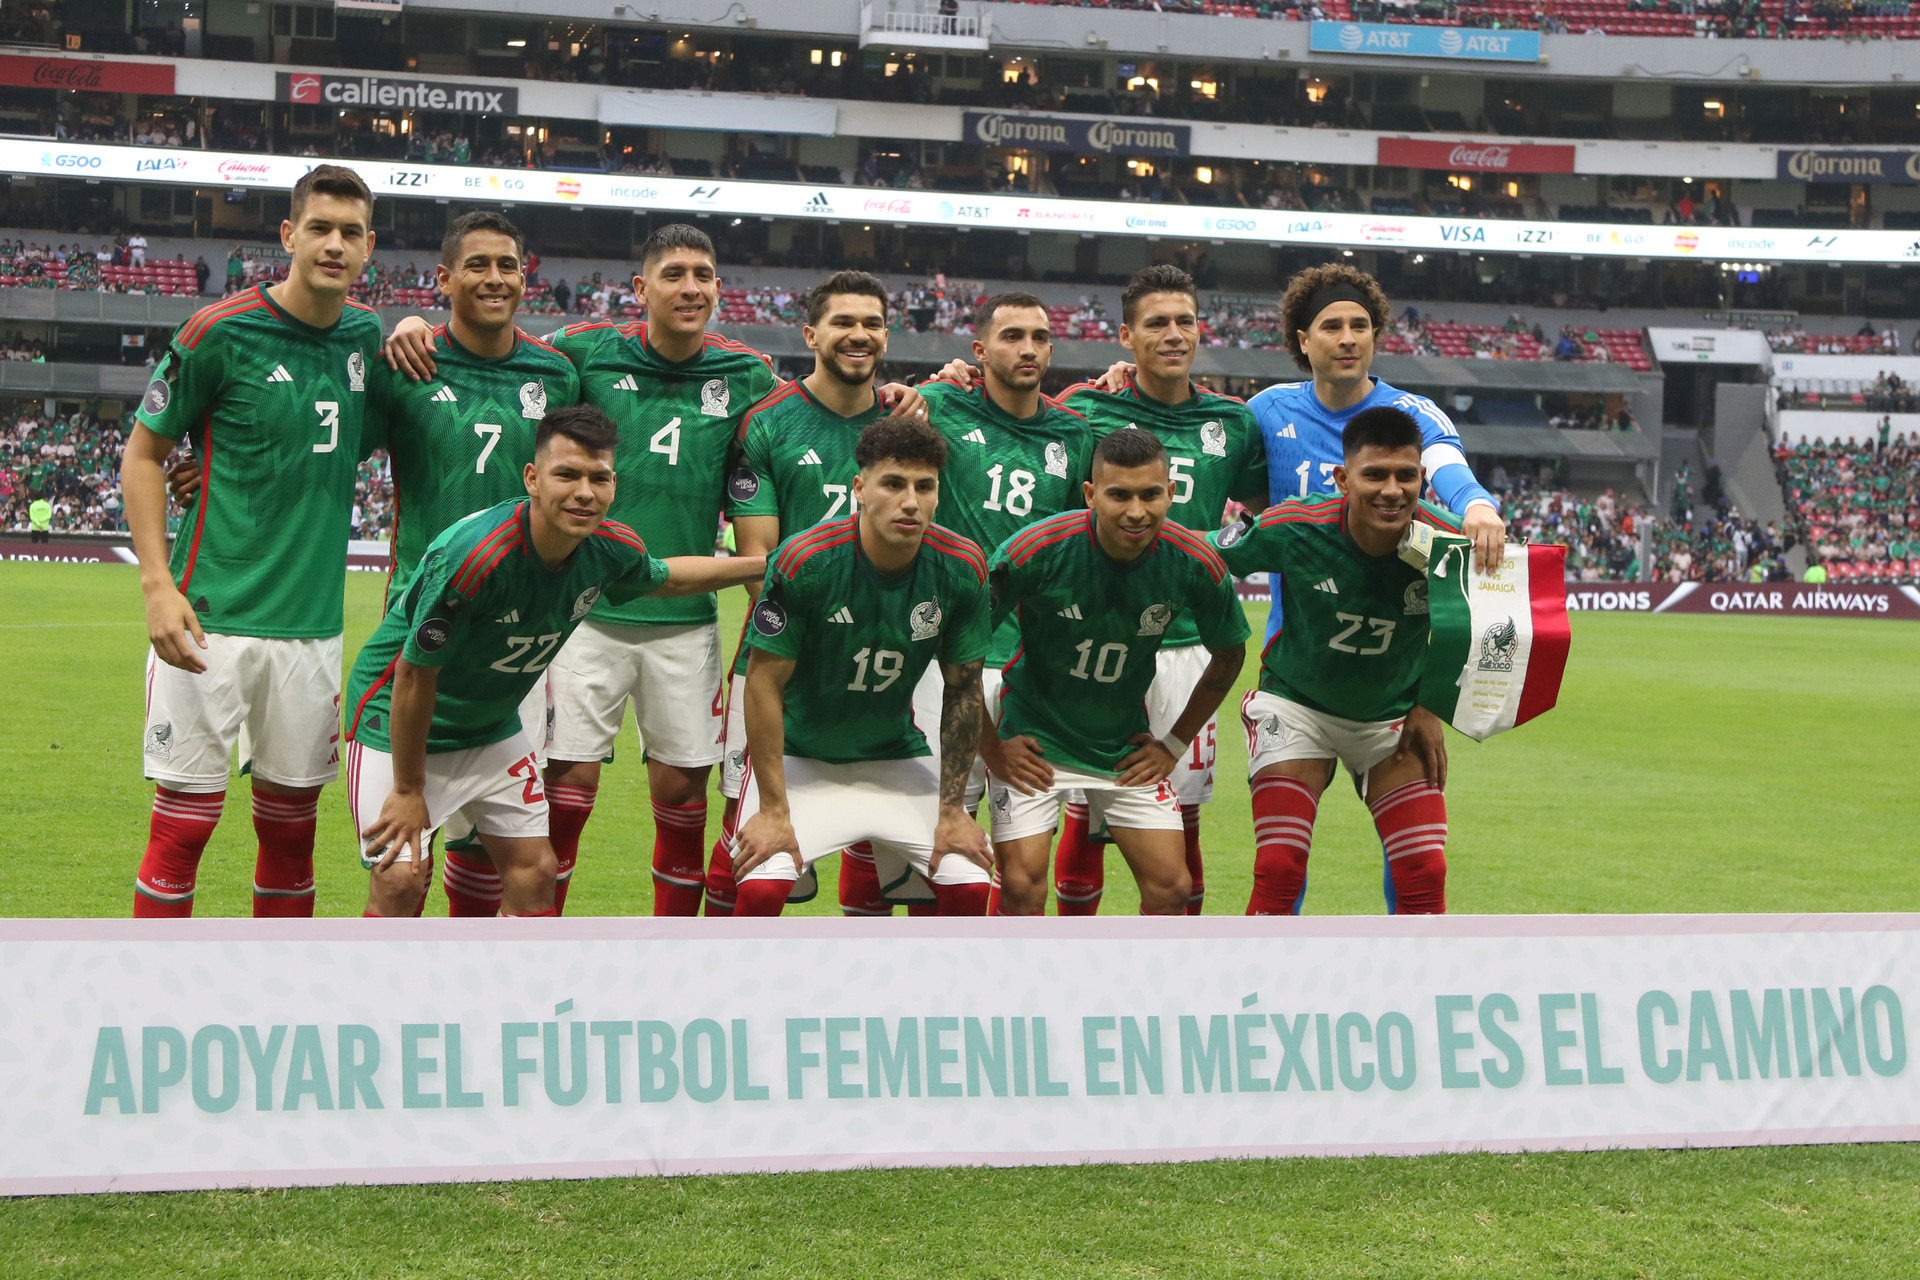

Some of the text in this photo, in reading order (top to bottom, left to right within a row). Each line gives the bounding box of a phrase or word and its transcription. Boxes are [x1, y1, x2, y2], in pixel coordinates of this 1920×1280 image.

[1366, 31, 1412, 48] AT&T
[1466, 35, 1512, 53] AT&T
[324, 77, 503, 113] caliente.mx
[976, 113, 1067, 146] Corona
[1087, 119, 1177, 152] Corona
[55, 154, 102, 168] G500
[136, 157, 176, 172] LALA
[218, 158, 271, 173] Caliente
[1787, 151, 1883, 182] Corona
[464, 176, 524, 190] BE GO
[610, 185, 658, 199] incode
[802, 204, 834, 214] adidas
[957, 206, 992, 218] AT&T
[1125, 215, 1168, 229] Corona
[1215, 218, 1256, 231] G500
[1287, 220, 1323, 234] LALA
[1439, 225, 1486, 242] VISA
[1586, 233, 1644, 245] BE GO
[242, 247, 261, 256] RUTA
[263, 248, 272, 256] DE
[1727, 238, 1775, 250] incode
[312, 401, 339, 453] 3
[474, 423, 502, 474] 7
[649, 417, 682, 466] 4
[983, 463, 1036, 516] 18
[1168, 456, 1195, 504] 5
[820, 484, 857, 521] 2
[1478, 582, 1516, 592] JAMAICA
[1566, 592, 1650, 611] ATIONS
[1710, 591, 1889, 612] QATAR AIRWAYS
[1328, 611, 1397, 655] 23
[490, 630, 562, 673] 22
[1069, 638, 1129, 683] 10
[847, 647, 904, 692] 19
[507, 752, 544, 805] 2
[83, 984, 1908, 1115] APOYAR EL FÚTBOL FEMENIL EN MÉXICO ES EL CAMINO
